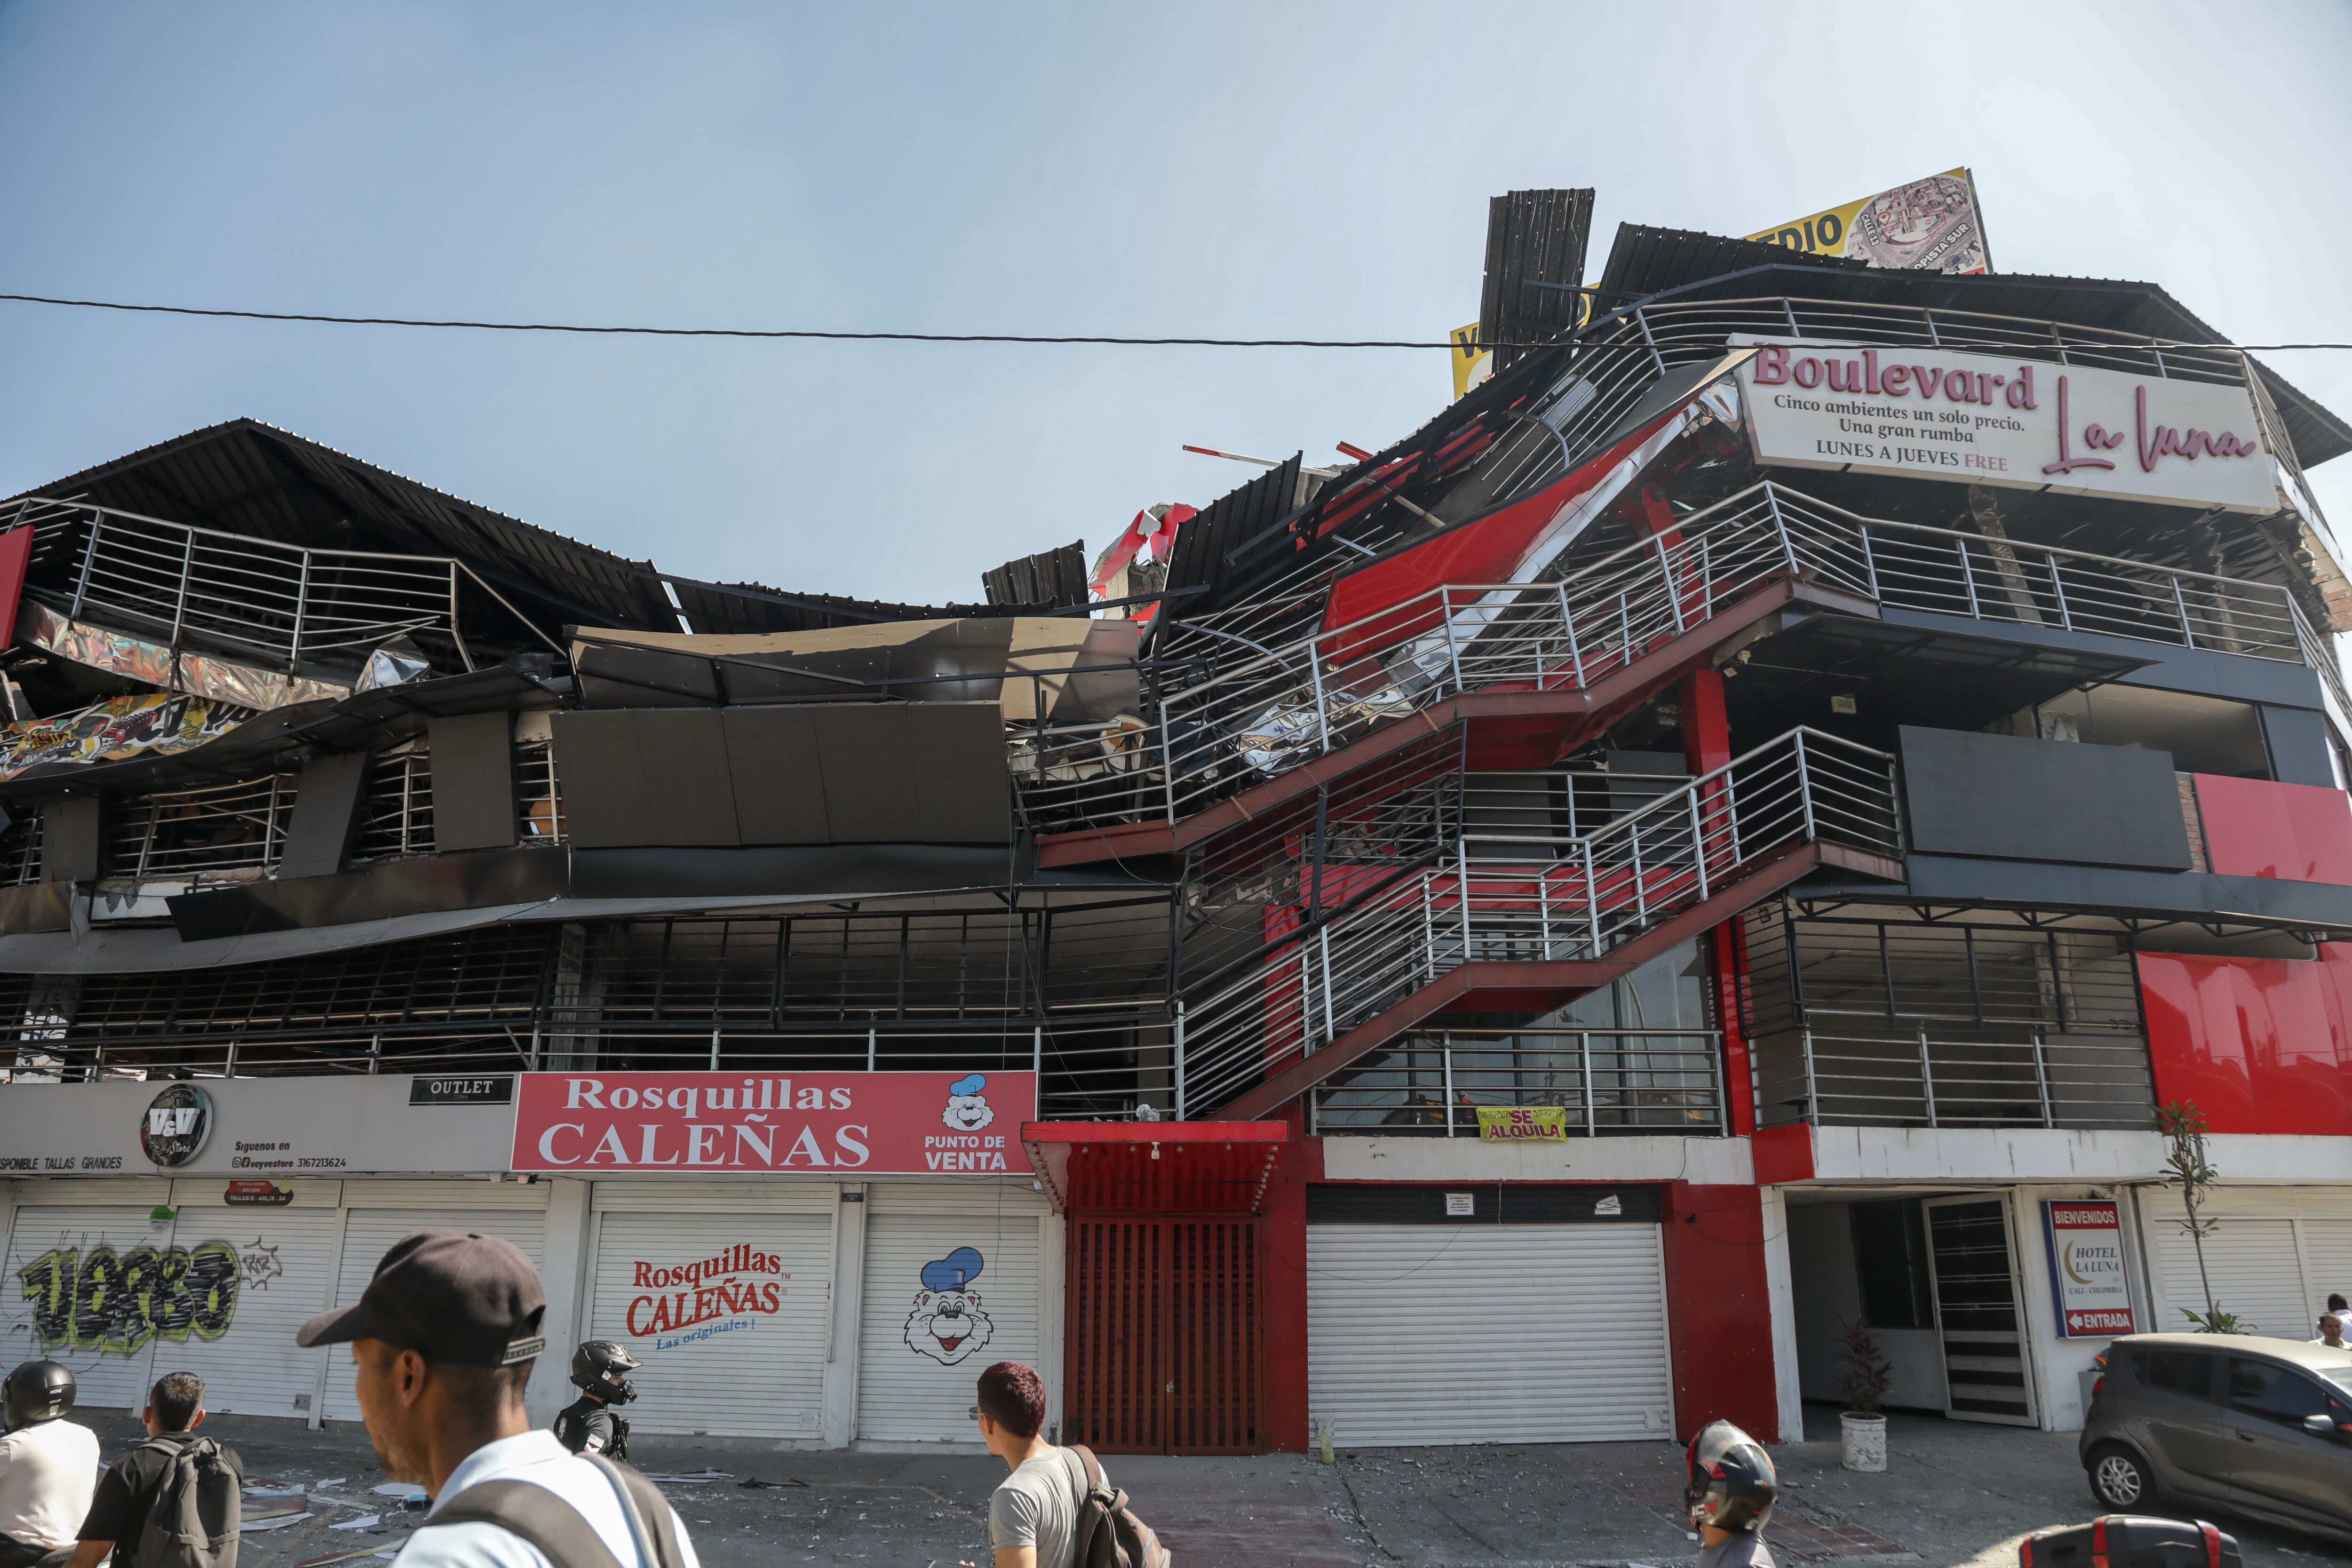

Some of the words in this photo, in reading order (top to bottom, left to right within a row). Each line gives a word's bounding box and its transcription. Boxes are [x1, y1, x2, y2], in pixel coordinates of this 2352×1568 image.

[1860, 213, 1876, 237] CALLE
[1869, 235, 1880, 246] 13
[1911, 241, 1950, 269] OPISTA
[1946, 223, 1971, 243] SUR
[1753, 342, 2039, 410] Boulevard
[1774, 394, 1820, 413] Cinco
[1825, 399, 1908, 420] ambientes
[1913, 409, 1935, 422] un
[1939, 406, 1970, 426] solo
[1974, 413, 2025, 434] precio.
[1839, 419, 1873, 437] Una
[1878, 427, 1915, 443] gran
[1920, 422, 1974, 443] rumba
[2042, 375, 2124, 475] La
[1816, 440, 1874, 459] LUNES
[1879, 445, 1892, 460] A
[1895, 446, 1959, 468] JUEVES
[1963, 452, 2008, 472] FREE
[431, 1081, 493, 1094] OUTLET
[563, 1078, 851, 1118] Rosquillas
[149, 1108, 201, 1137] V&V
[1510, 1110, 1534, 1124] SE
[538, 1113, 870, 1167] CALEÑAS
[1489, 1124, 1561, 1138] ALQUILA
[169, 1141, 191, 1154] Store
[925, 1136, 982, 1148] PUNTO
[985, 1136, 1005, 1148] DE
[0, 1158, 39, 1170] SPONIBLE
[45, 1157, 75, 1170] TALLAS
[82, 1156, 122, 1169] GRANDES
[250, 1159, 294, 1170] veyvestore
[297, 1158, 346, 1167] 3167213624
[925, 1152, 1007, 1170] VENTA
[2054, 1210, 2115, 1224] BIENVENIDOS
[2076, 1248, 2117, 1258] HOTEL
[633, 1243, 781, 1289] Rosquillas
[2091, 1261, 2119, 1272] LUNA
[627, 1277, 780, 1337] CALEÑAS
[2084, 1313, 2131, 1329] ENTRADA
[656, 1337, 680, 1350] Las
[683, 1320, 748, 1345] originales
[1692, 1501, 1716, 1517] ICH
